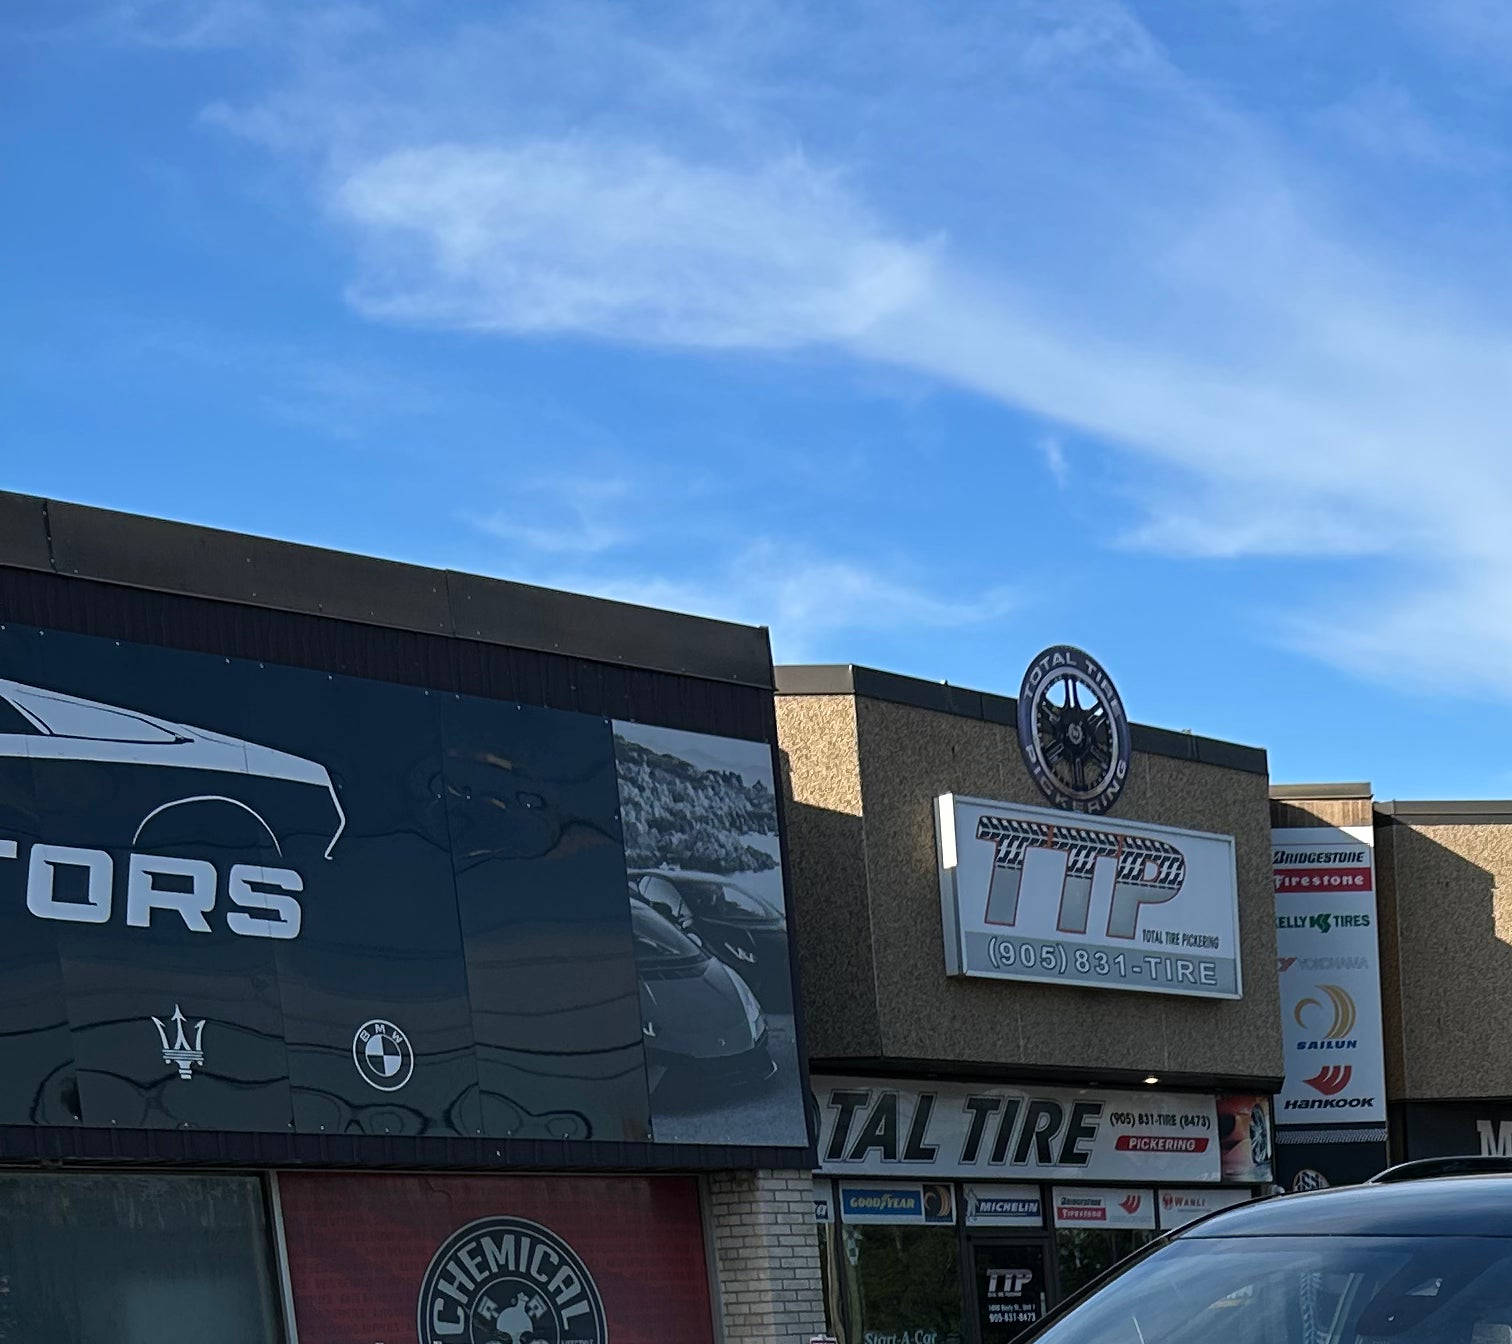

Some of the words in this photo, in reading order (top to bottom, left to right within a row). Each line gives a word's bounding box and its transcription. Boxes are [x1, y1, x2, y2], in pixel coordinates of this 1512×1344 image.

[1024, 652, 1077, 700] TOTAL
[1085, 659, 1121, 718] TIRE
[1025, 743, 1127, 815] PICKERING
[1272, 850, 1365, 865] BRIDGESTONE
[977, 815, 1186, 940] TTP
[1273, 874, 1365, 890] Firestone
[0, 840, 304, 939] ORS
[1275, 915, 1308, 929] ELLY
[1333, 914, 1370, 928] TIRES
[1142, 928, 1164, 944] TOTAL
[1165, 931, 1181, 945] TIRE
[1181, 932, 1221, 949] PICKERING
[988, 936, 1069, 975] (905)
[1074, 948, 1218, 985] 831-TIRE
[359, 1023, 403, 1044] BMW
[1296, 1040, 1358, 1050] SAILUN
[815, 1088, 940, 1164] TAL
[958, 1093, 1105, 1168] TIRE
[1109, 1111, 1136, 1128] (905)
[1138, 1111, 1177, 1127] 831-TIRE
[1180, 1114, 1212, 1130] (8473)
[1128, 1137, 1196, 1151] PICKERING
[850, 1194, 915, 1210] GOODYEAR
[979, 1201, 1039, 1213] MICHELIN
[432, 1233, 591, 1335] CHEMICAL
[986, 1268, 1033, 1292] TTP
